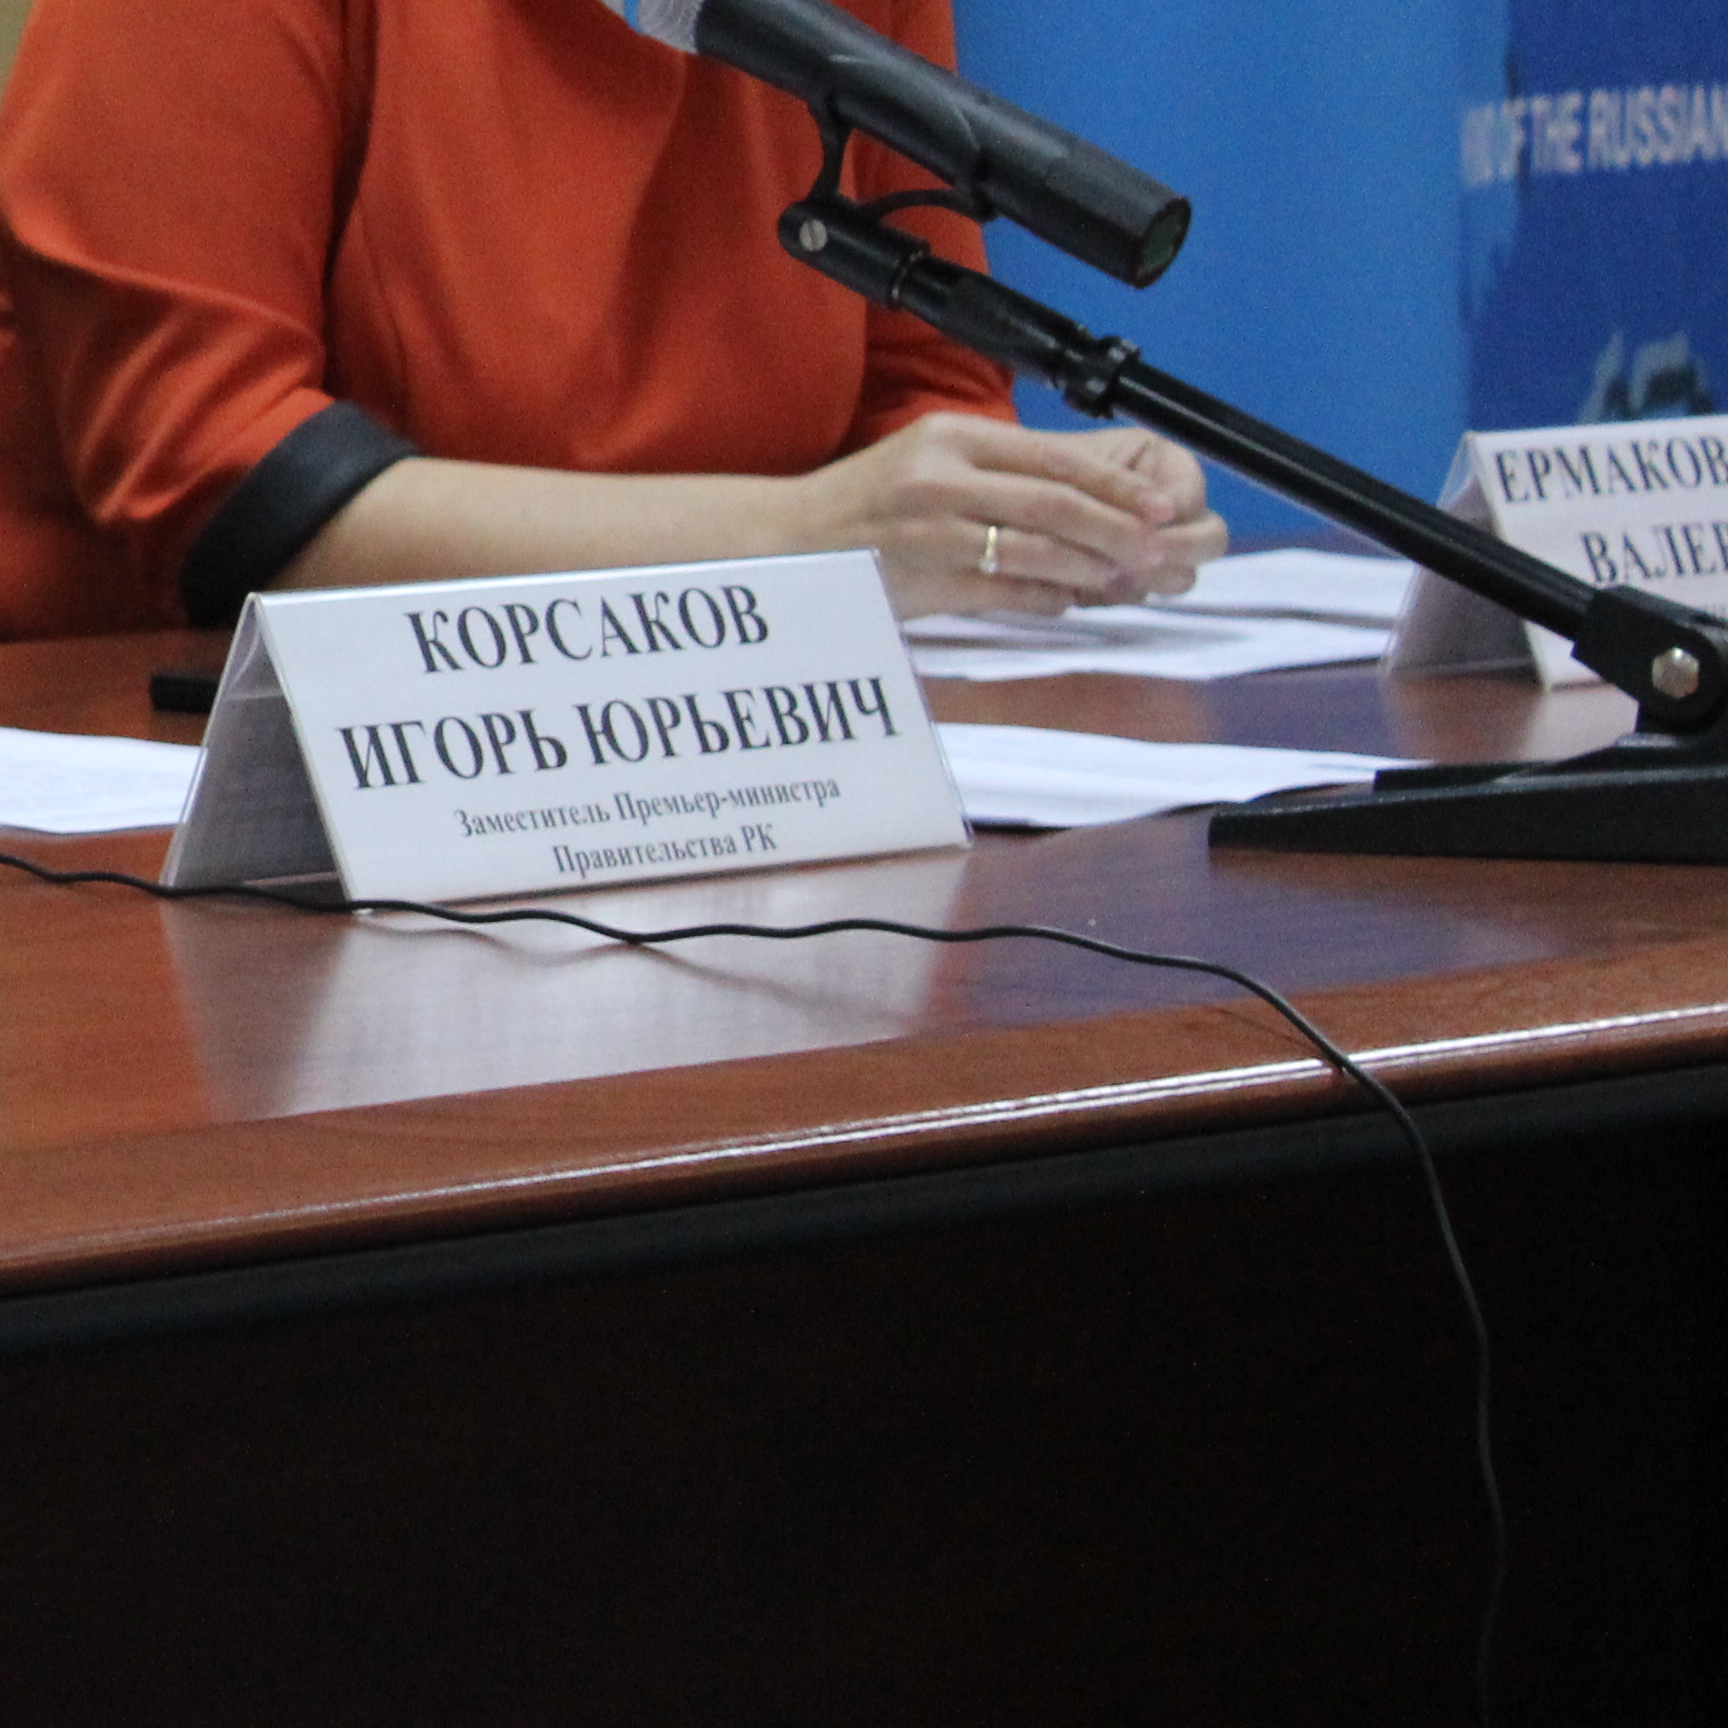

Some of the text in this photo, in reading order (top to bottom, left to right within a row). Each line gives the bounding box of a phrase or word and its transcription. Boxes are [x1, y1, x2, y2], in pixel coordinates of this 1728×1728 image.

[1530, 90, 1584, 174] THE
[407, 584, 770, 674] КОРСАКОВ
[335, 676, 902, 790] ИГОРЬ ЮРЬЕВИЧ
[454, 777, 842, 838] Заместитель Премьер-министра
[552, 822, 778, 879] Правительства РК
